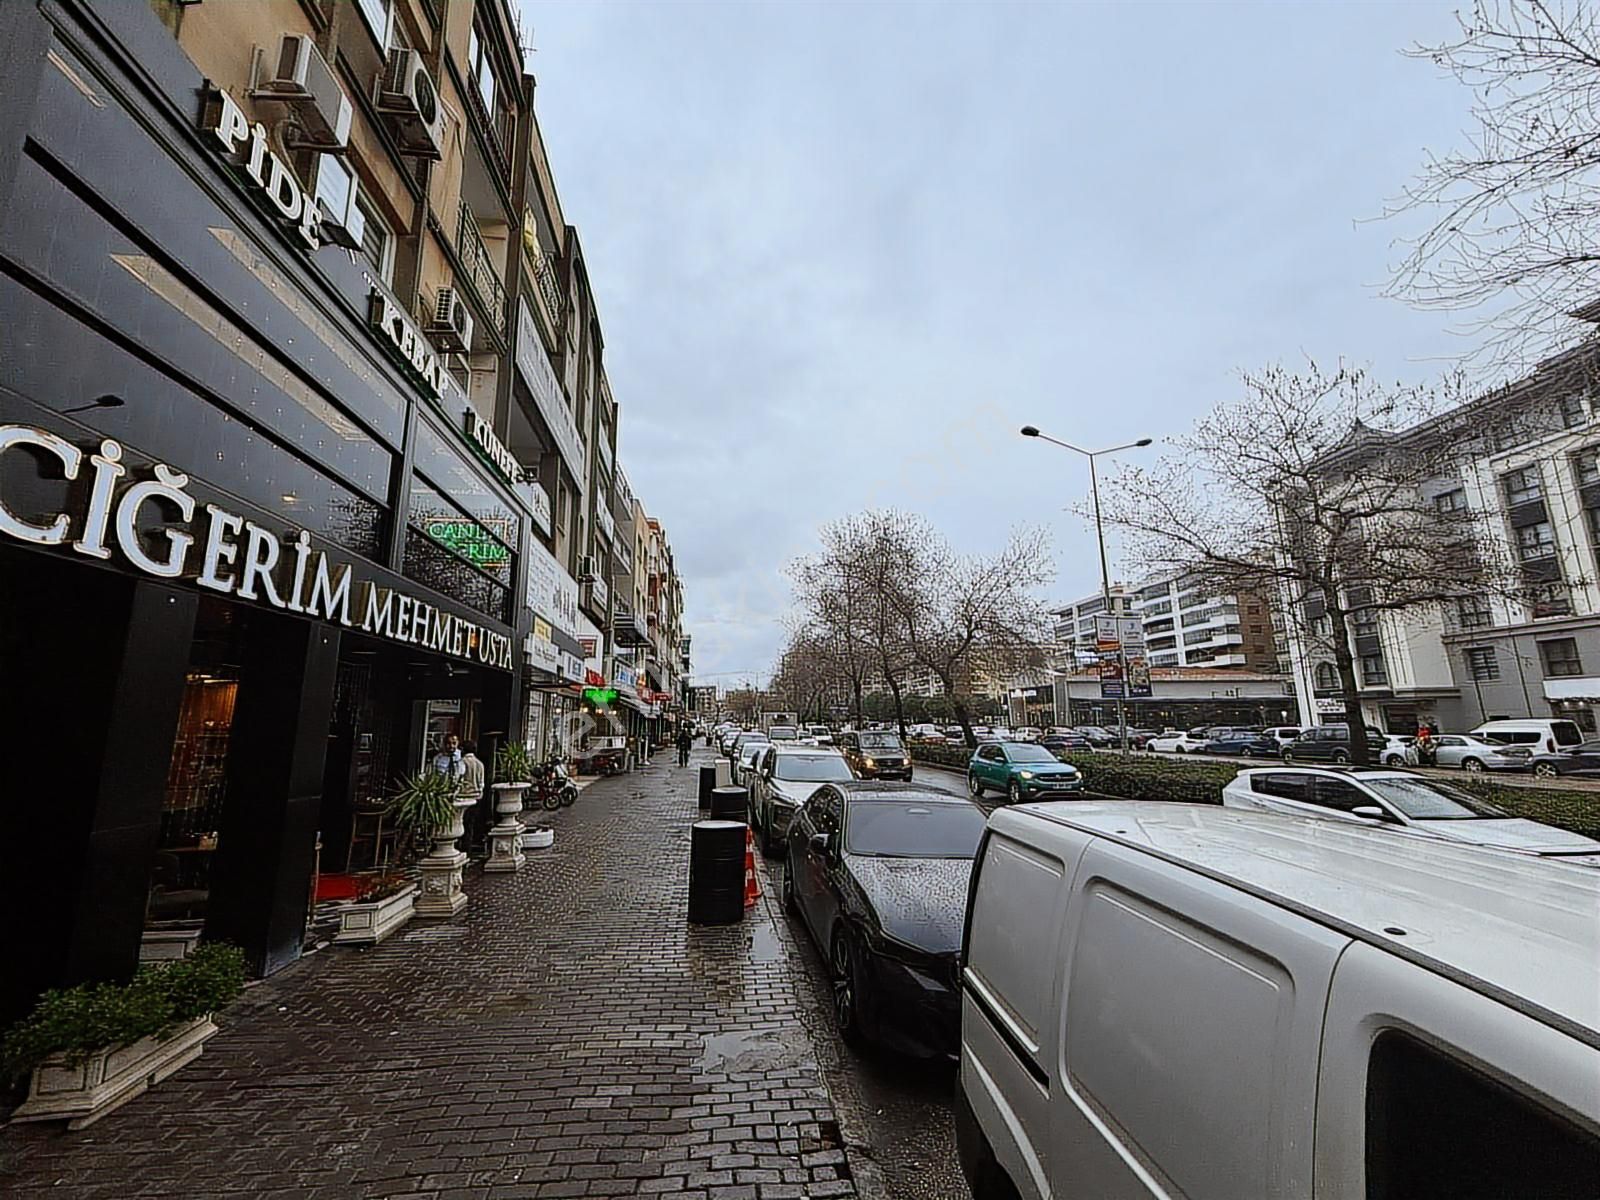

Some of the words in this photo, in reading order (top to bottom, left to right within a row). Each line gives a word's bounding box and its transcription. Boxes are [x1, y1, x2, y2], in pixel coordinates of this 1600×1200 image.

[215, 88, 323, 250] PİDE
[381, 296, 450, 400] KEBAP
[0, 424, 351, 626] CİĞERİM
[361, 582, 475, 658] MEHMET
[479, 627, 513, 670] USTA
